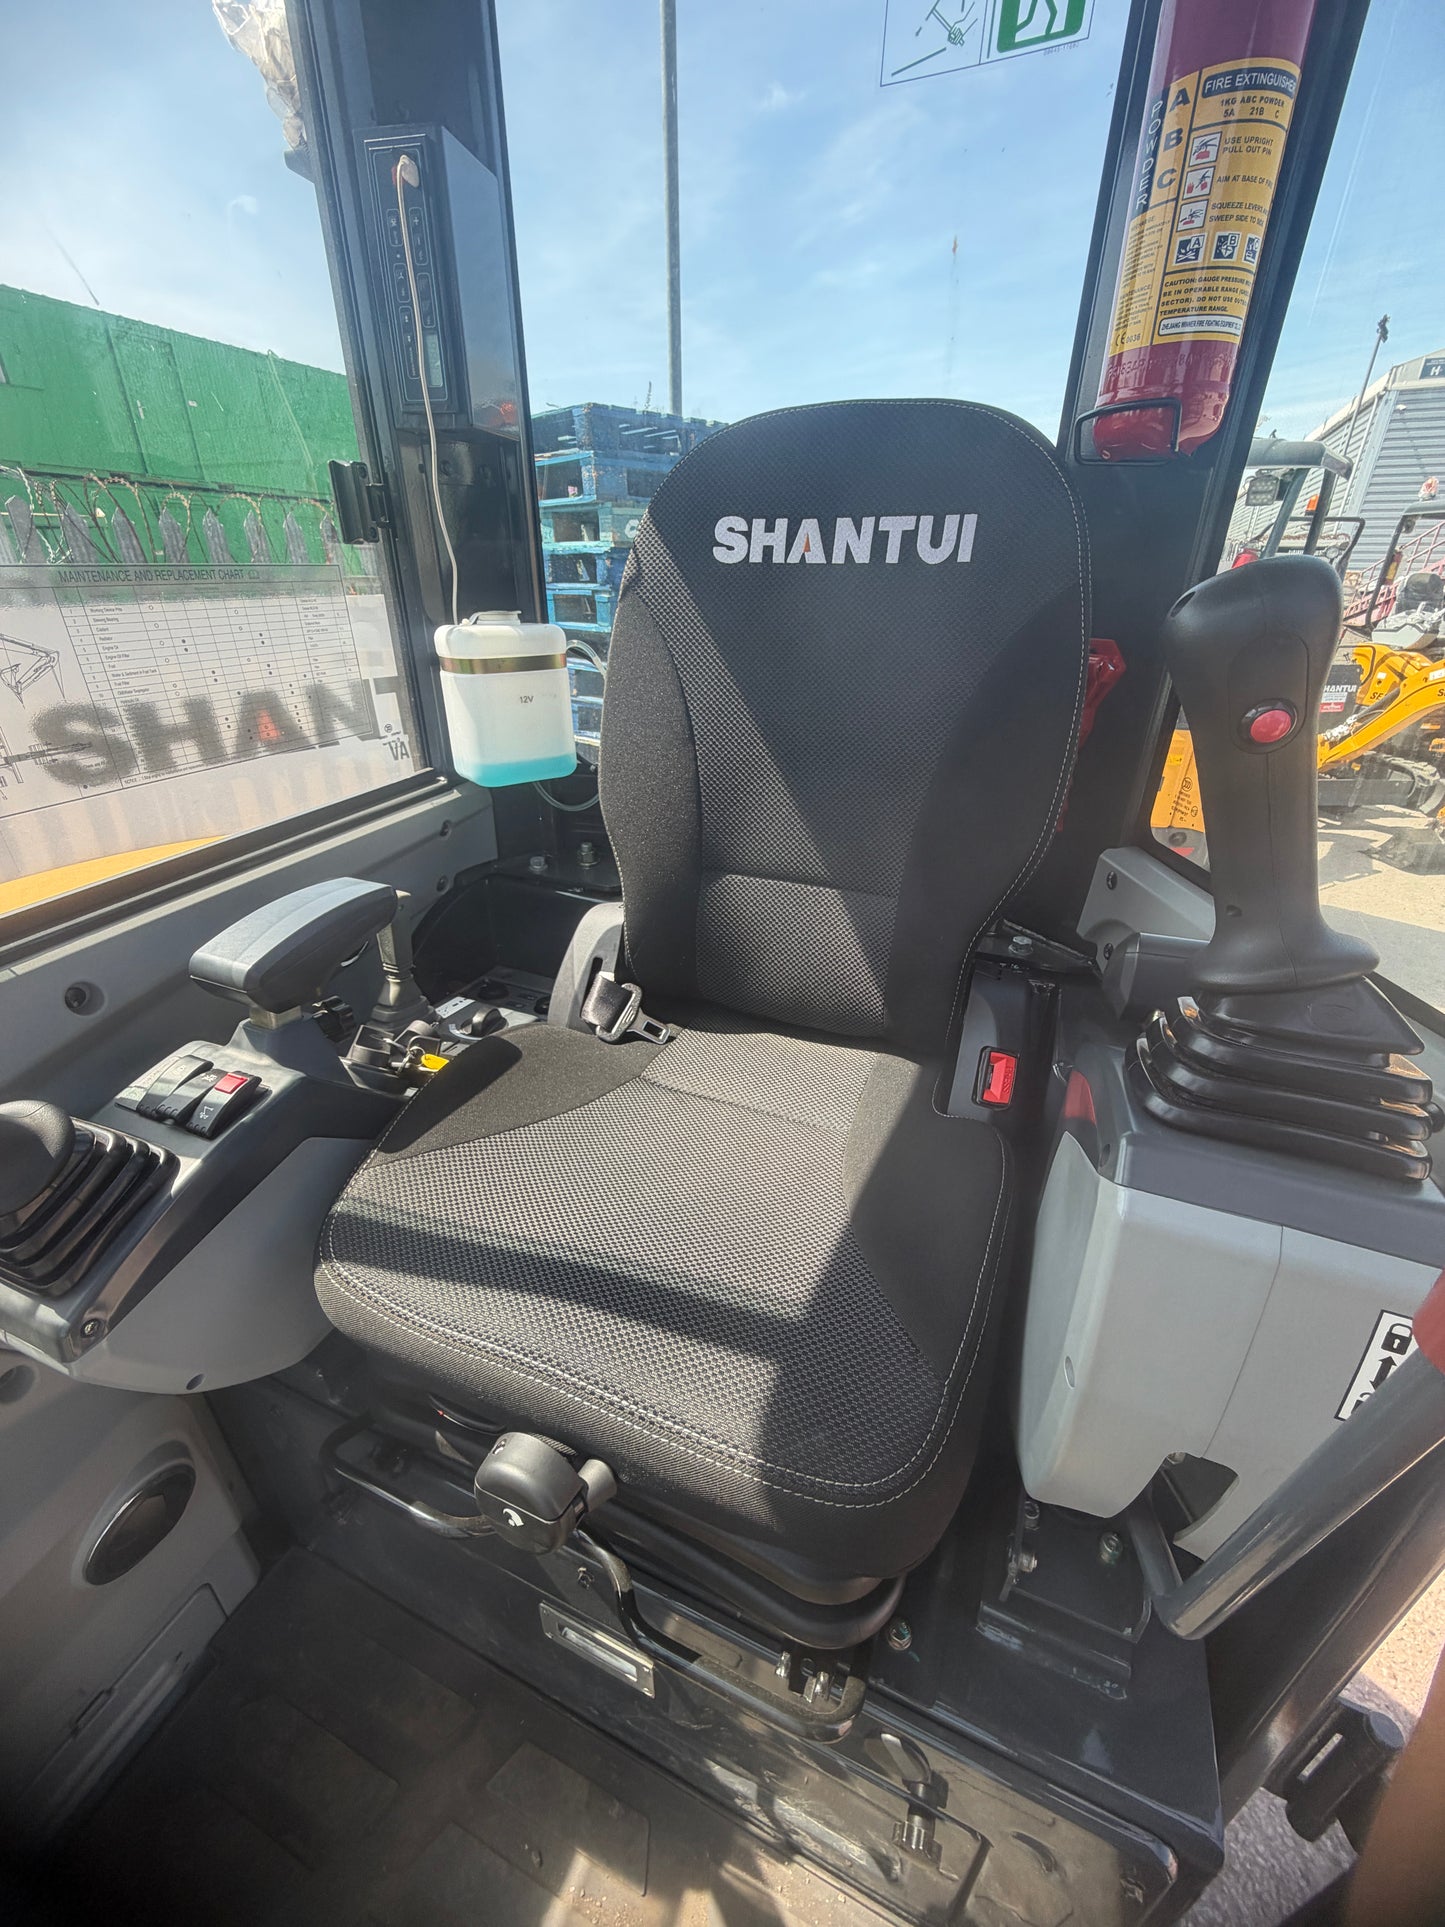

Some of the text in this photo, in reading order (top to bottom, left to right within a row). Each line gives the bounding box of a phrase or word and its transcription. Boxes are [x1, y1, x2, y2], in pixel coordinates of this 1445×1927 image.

[1204, 76, 1232, 93] FIRE
[1169, 87, 1191, 112] A
[1221, 96, 1285, 108] 1KG ABC POWDER
[1223, 109, 1235, 118] 5A
[1249, 107, 1265, 116] 21B
[1163, 128, 1183, 152] B
[1225, 136, 1274, 147] USE UPRIGHT
[1136, 100, 1164, 210] POWDER
[1222, 145, 1272, 156] PULL OUT PIN
[1157, 168, 1178, 190] C
[1241, 175, 1258, 184] BASE
[1211, 202, 1244, 210] SQUEEZE
[1209, 215, 1234, 223] SWEEP
[1235, 214, 1249, 222] SIDE
[1250, 215, 1257, 223] TO
[1164, 277, 1197, 287] CAUTION:
[1220, 276, 1245, 286] PRESSURE
[1183, 286, 1219, 294] OPERABLE
[1160, 306, 1208, 316] TEMPERATURE
[712, 513, 978, 565] SHANTUI
[58, 568, 245, 584] MAINTENANCE AND REPLACEMENT CHART
[1323, 684, 1357, 693] HANTUI
[519, 695, 535, 704] 12V
